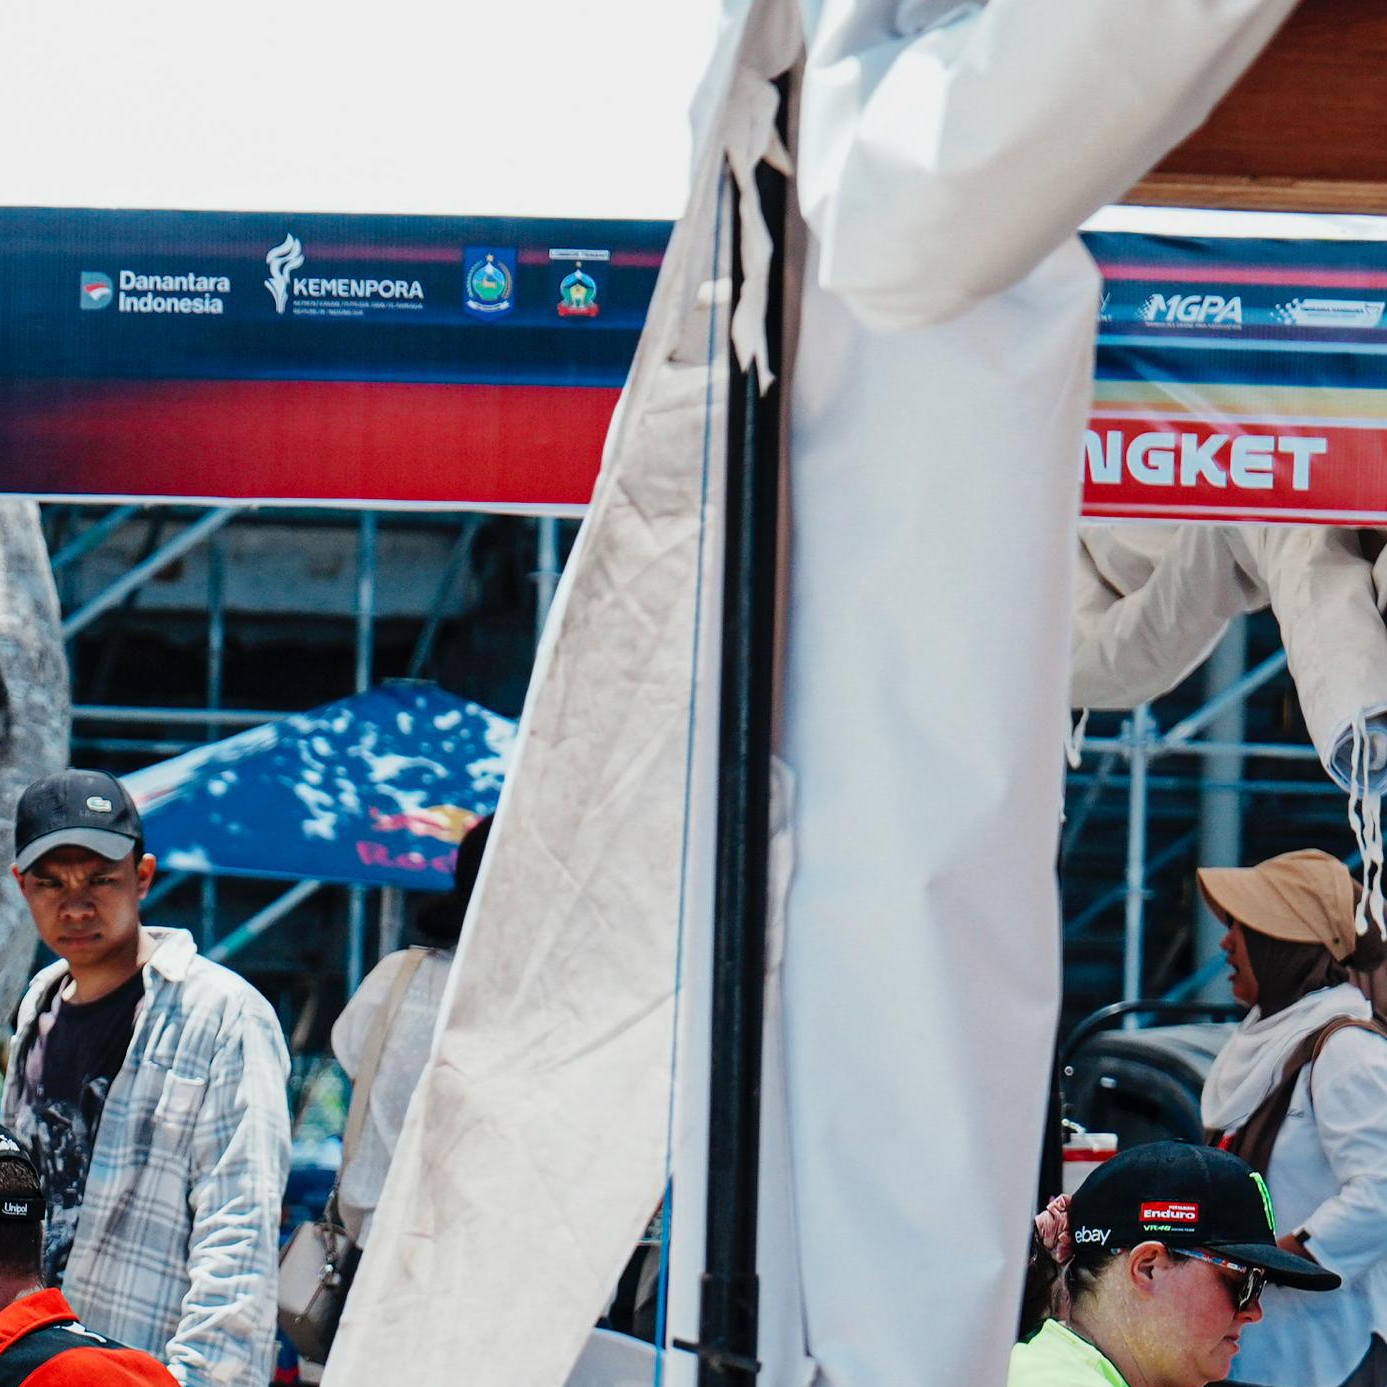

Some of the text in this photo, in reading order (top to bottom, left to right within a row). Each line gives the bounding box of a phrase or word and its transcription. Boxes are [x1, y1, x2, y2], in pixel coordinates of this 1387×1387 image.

[119, 270, 231, 293] Danantara
[293, 278, 425, 299] KEMENPORA
[119, 291, 223, 315] Indonesia
[1144, 293, 1243, 323] MGPA
[3, 1202, 28, 1216] Unipol
[1143, 1209, 1196, 1220] Enduro
[1075, 1226, 1112, 1246] ebay
